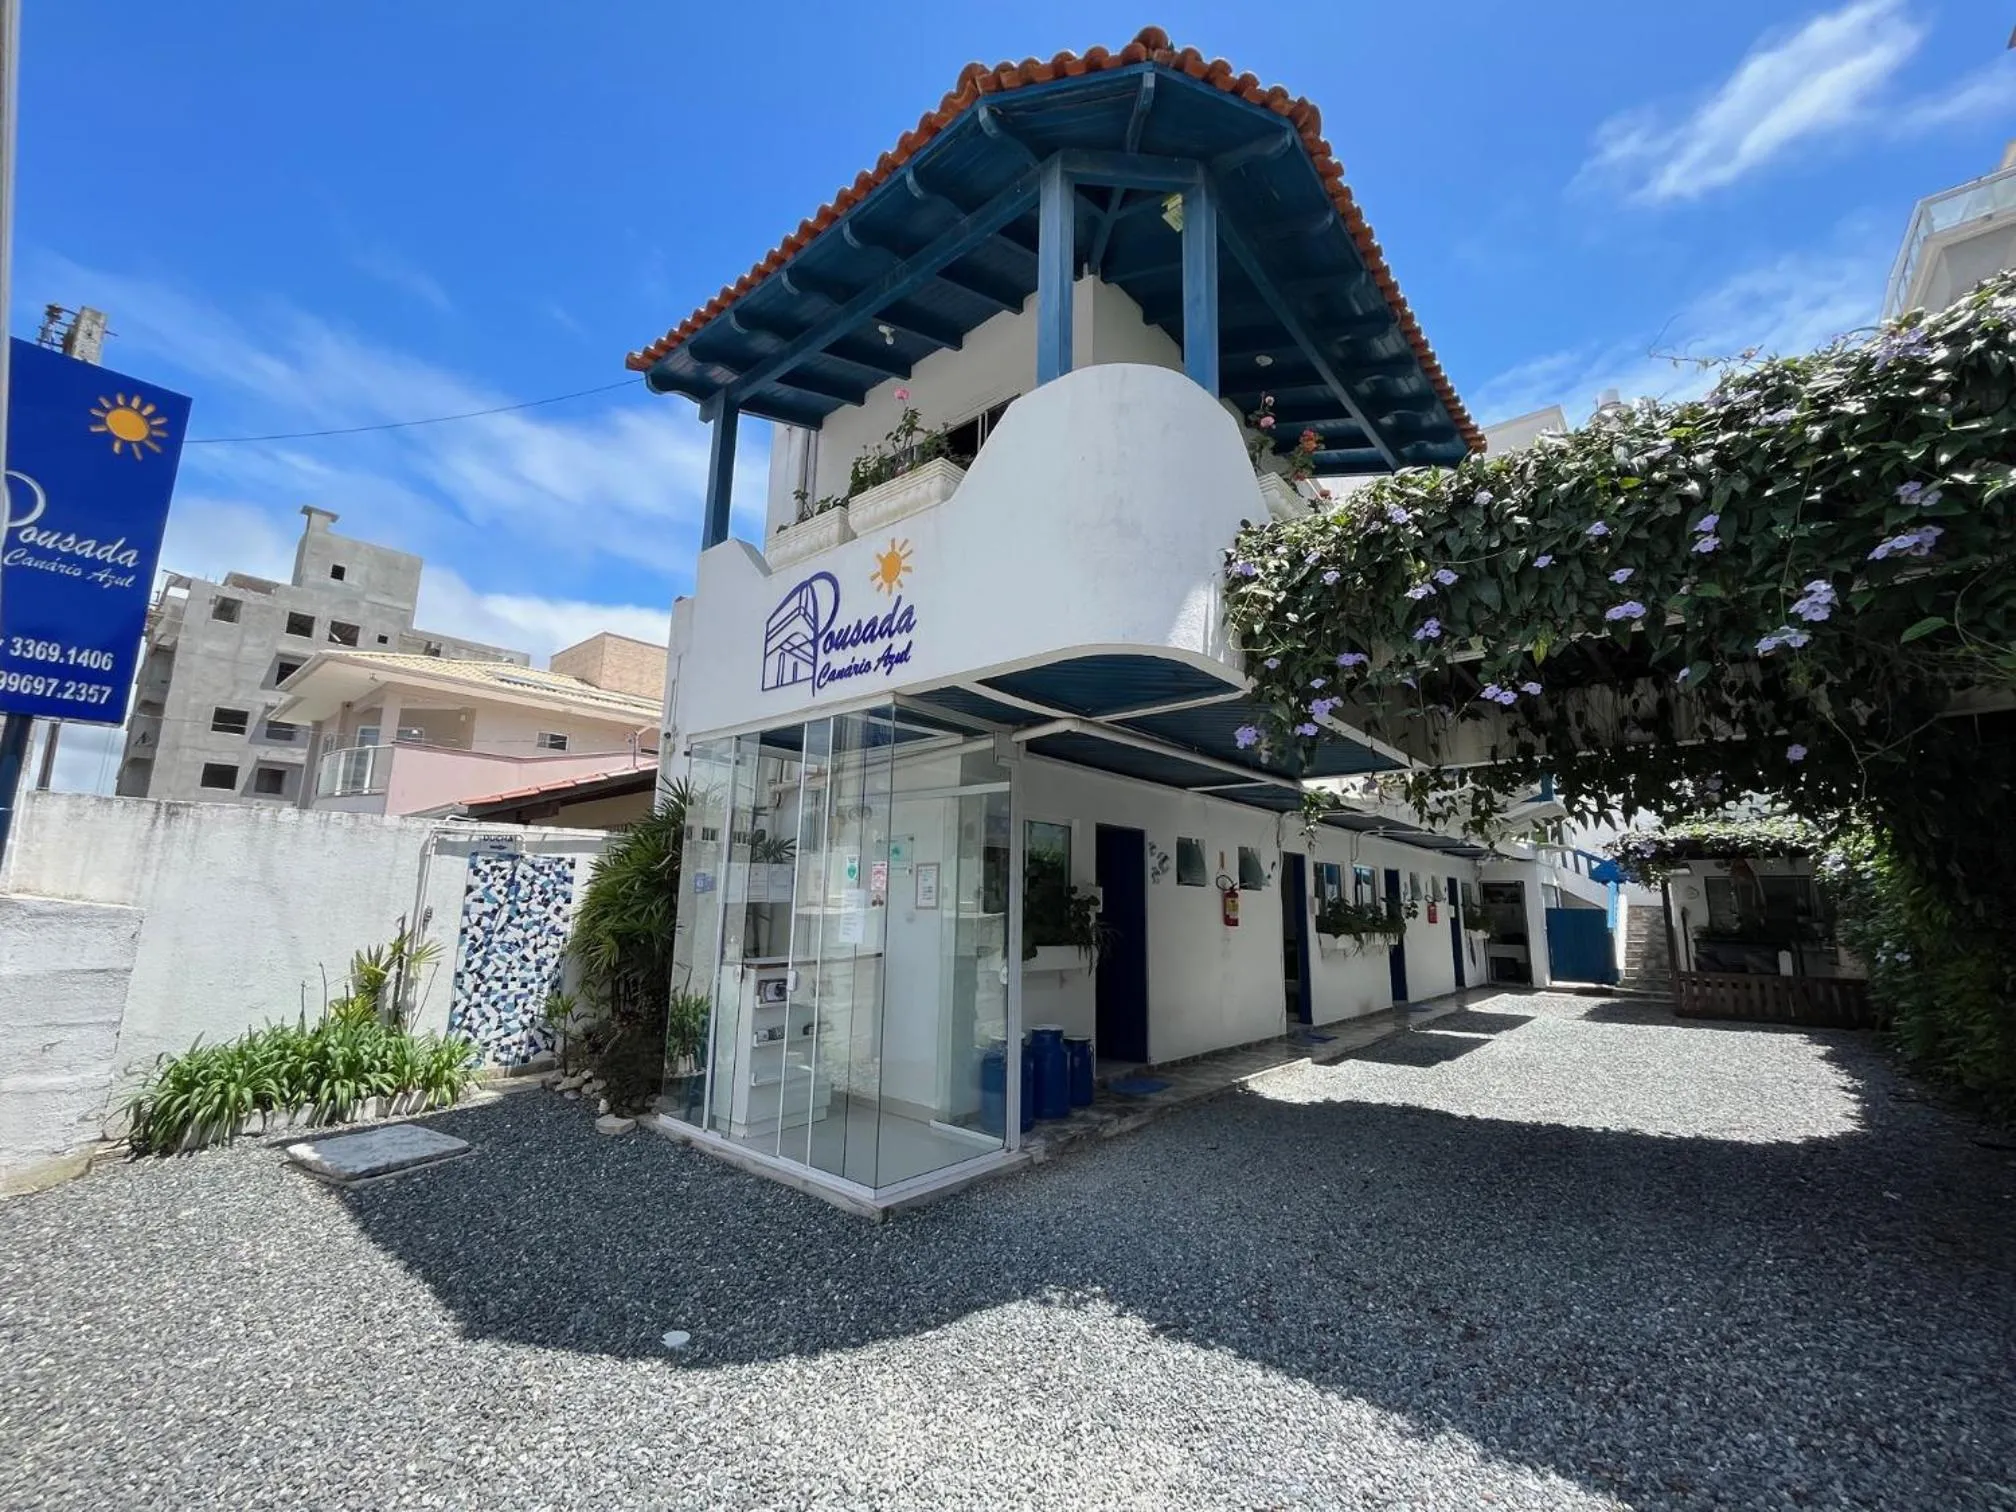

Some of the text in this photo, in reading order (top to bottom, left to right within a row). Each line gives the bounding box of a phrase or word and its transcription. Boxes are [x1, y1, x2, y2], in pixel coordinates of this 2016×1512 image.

[3, 470, 140, 568] Pousada
[3, 547, 136, 588] Canário Azul
[9, 637, 114, 671] 3369.1406
[807, 571, 917, 697] Pousada
[817, 640, 913, 689] Canário Azul
